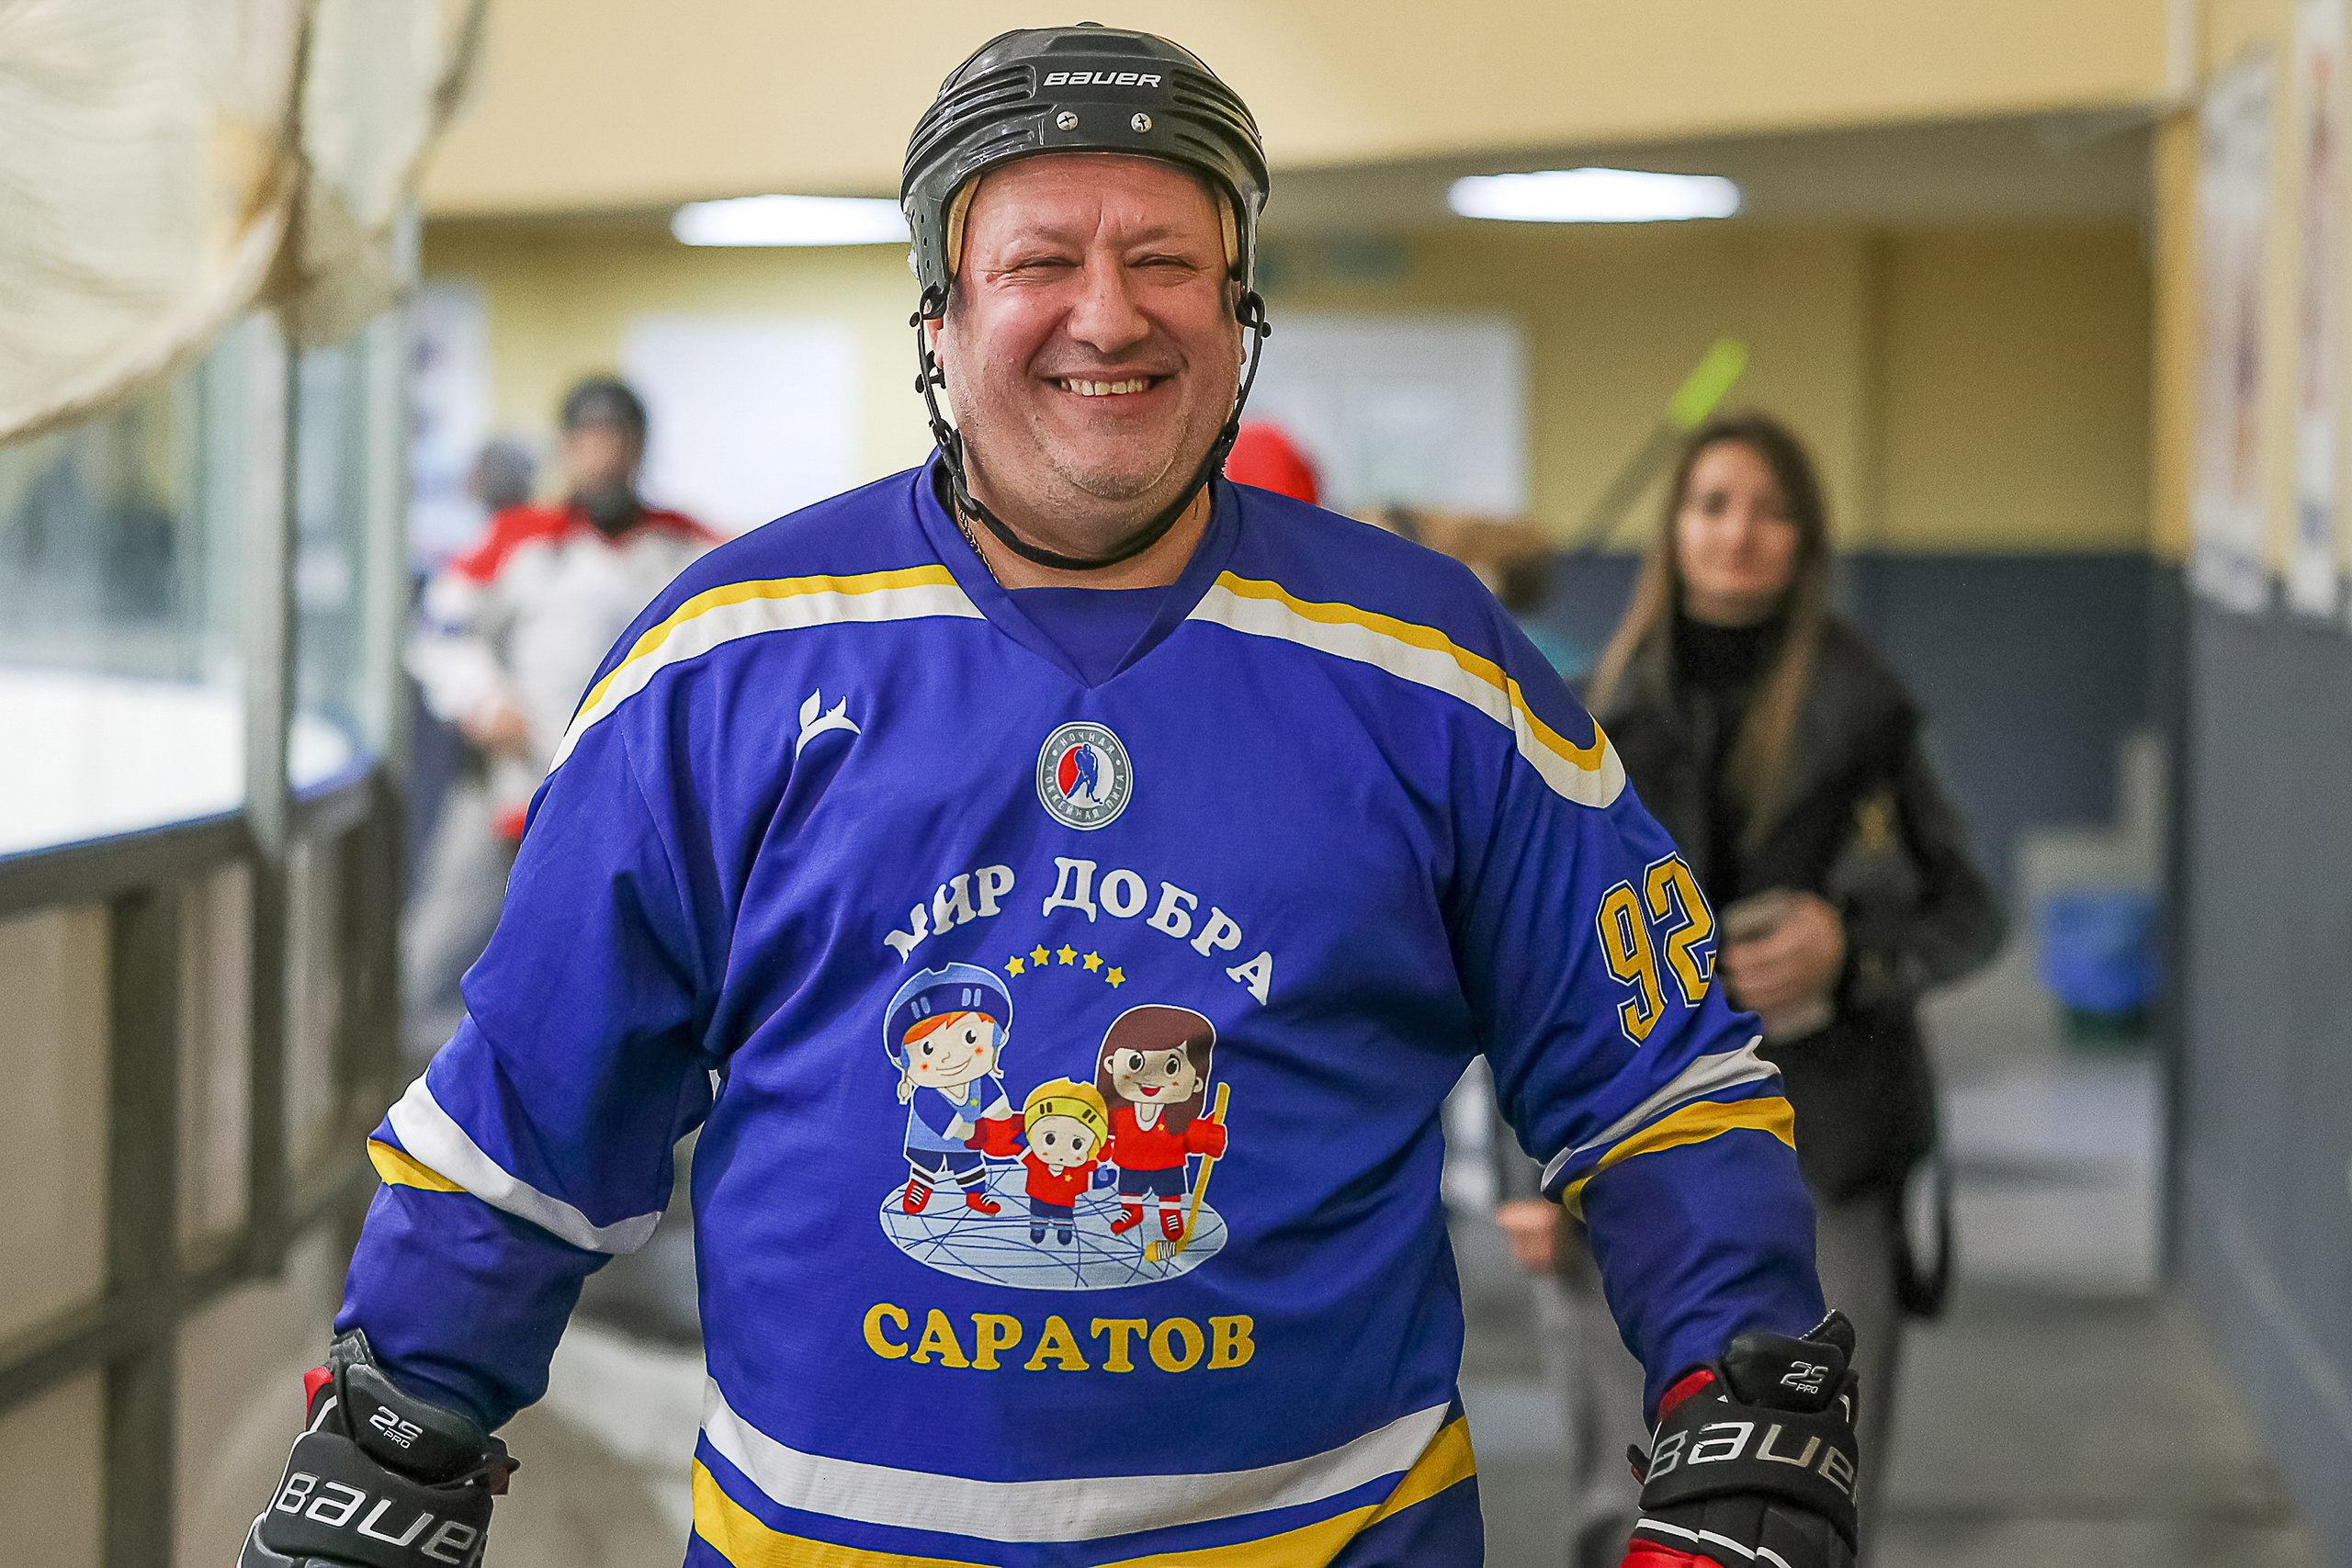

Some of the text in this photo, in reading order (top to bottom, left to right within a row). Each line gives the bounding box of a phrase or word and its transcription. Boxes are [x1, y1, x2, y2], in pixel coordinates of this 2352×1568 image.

[1043, 71, 1162, 88] BAUER
[1059, 732, 1115, 753] НОЧНАЯ
[1106, 774, 1125, 809] ЛИГА
[884, 856, 1274, 1006] МИР ДОБРА
[1595, 851, 1716, 1047] 92
[863, 1303, 1256, 1373] САРАТОВ
[1795, 1382, 1819, 1394] PRO
[383, 1429, 412, 1450] PRO
[1645, 1421, 1857, 1507] BAUE
[275, 1472, 483, 1567] BAUE
